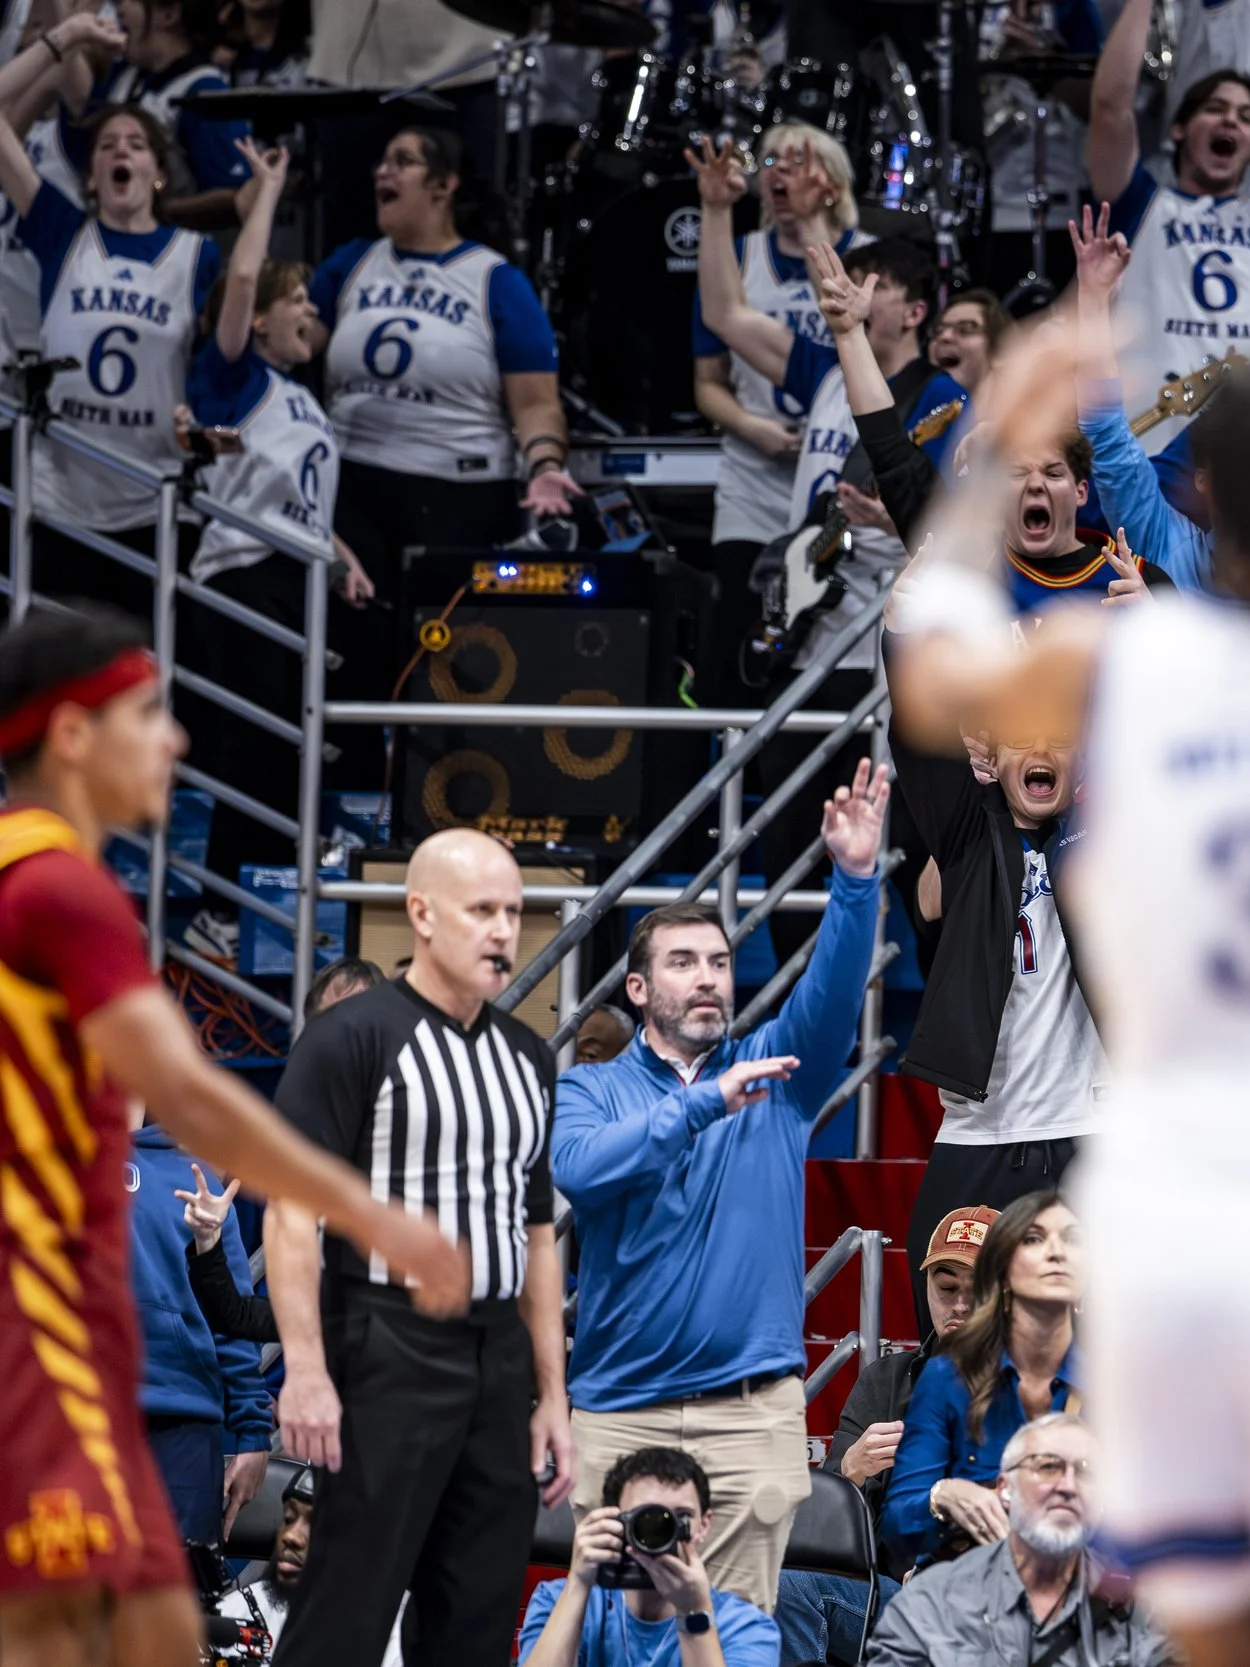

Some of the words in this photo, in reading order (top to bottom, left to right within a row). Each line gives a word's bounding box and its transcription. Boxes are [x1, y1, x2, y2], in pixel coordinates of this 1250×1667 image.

[70, 286, 172, 327] KANSAS
[358, 285, 471, 325] KANSAS
[1193, 250, 1238, 312] 6
[88, 326, 138, 396] 6
[363, 317, 419, 379] 6
[302, 442, 328, 510] 6
